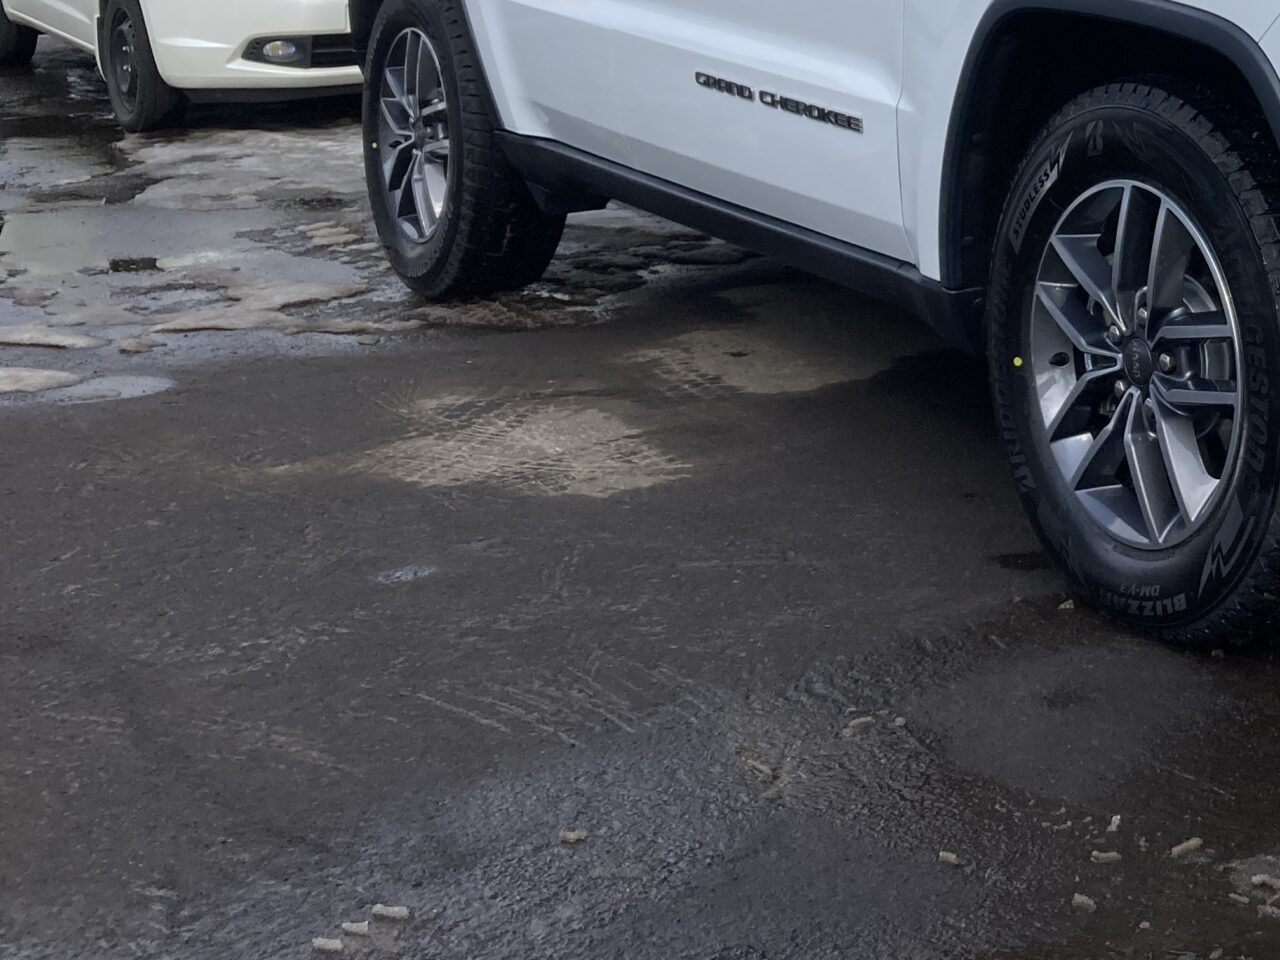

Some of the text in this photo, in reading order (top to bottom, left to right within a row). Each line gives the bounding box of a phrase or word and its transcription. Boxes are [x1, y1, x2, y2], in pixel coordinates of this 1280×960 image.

[695, 71, 864, 134] GRAND CHEROKEE
[1012, 167, 1052, 240] STUDLESS
